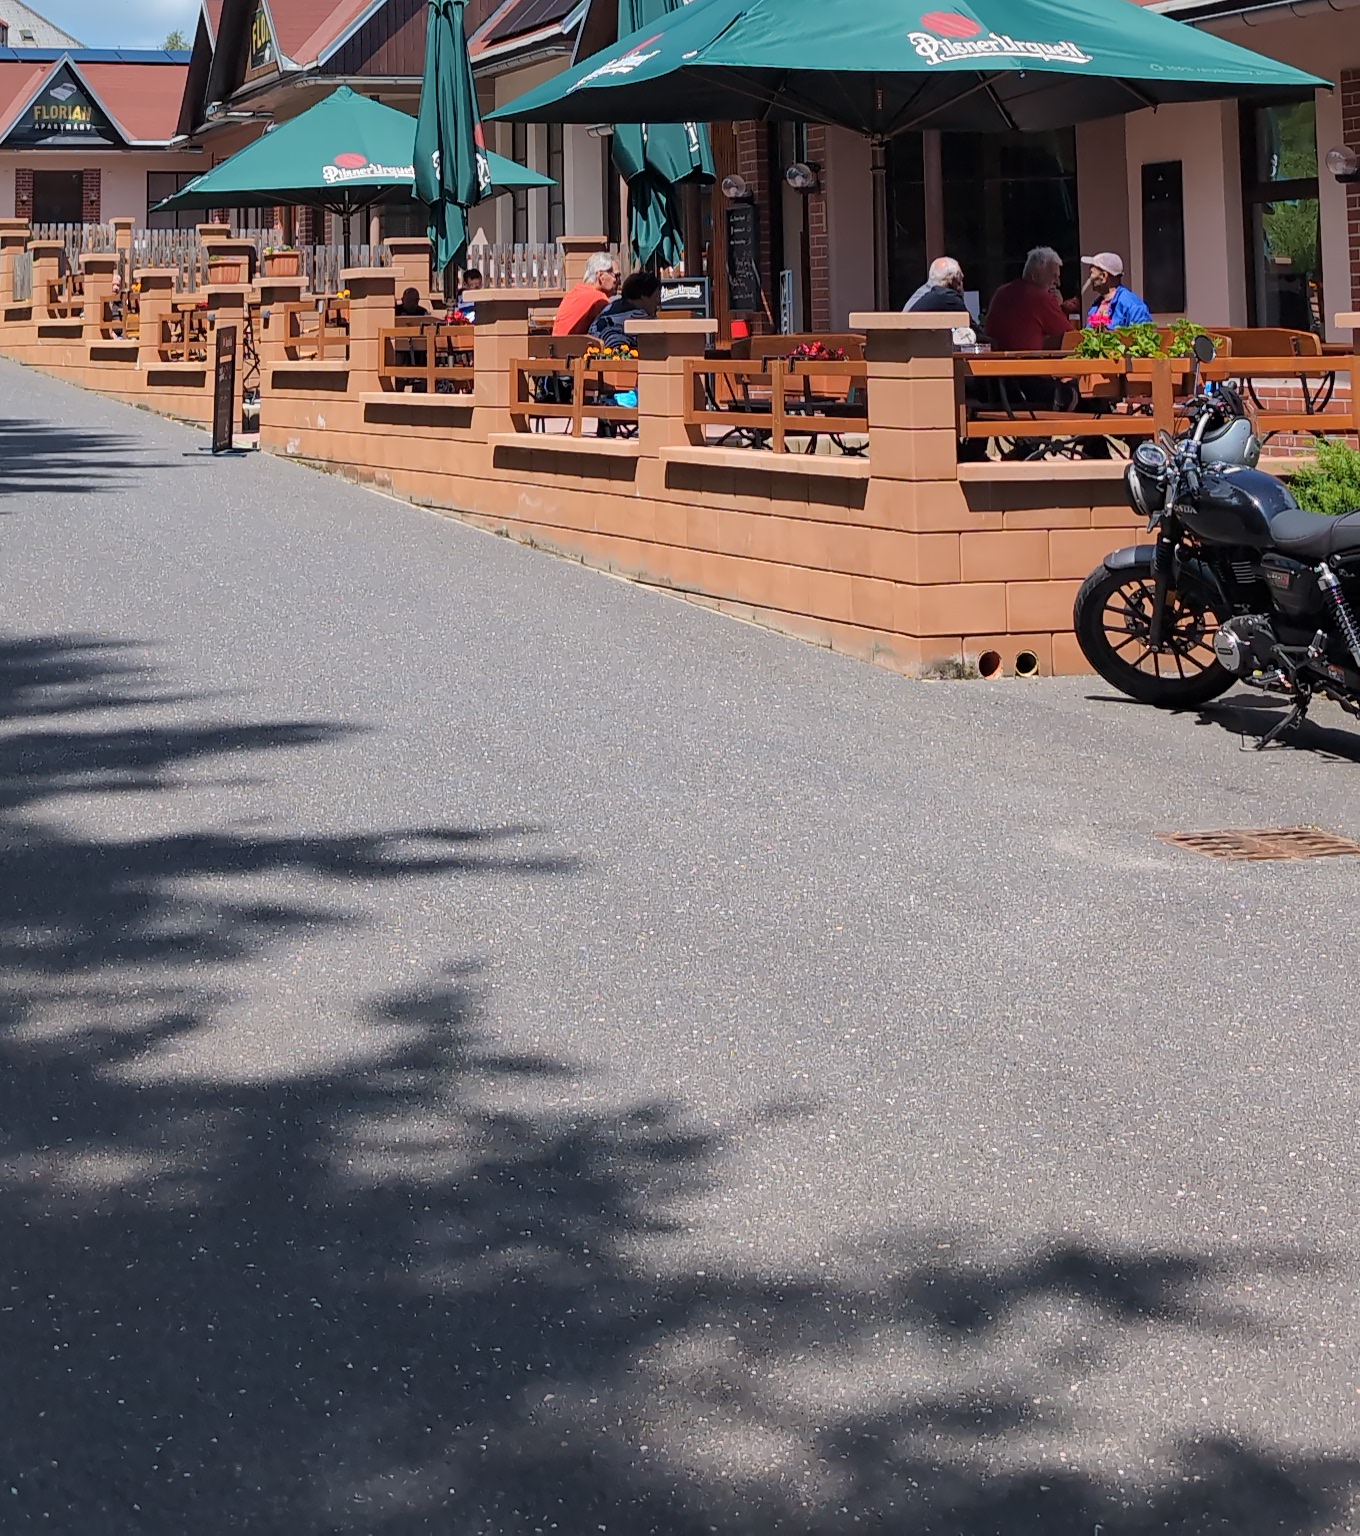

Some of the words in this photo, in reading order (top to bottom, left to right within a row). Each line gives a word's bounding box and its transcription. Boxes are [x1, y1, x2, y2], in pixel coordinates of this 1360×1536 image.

[907, 32, 998, 65] Pilsner
[989, 32, 1089, 63] Urquell
[33, 105, 92, 121] FLORIAN
[322, 165, 373, 184] Pilsner
[369, 163, 415, 178] Urquel
[1173, 504, 1198, 514] ONDA
